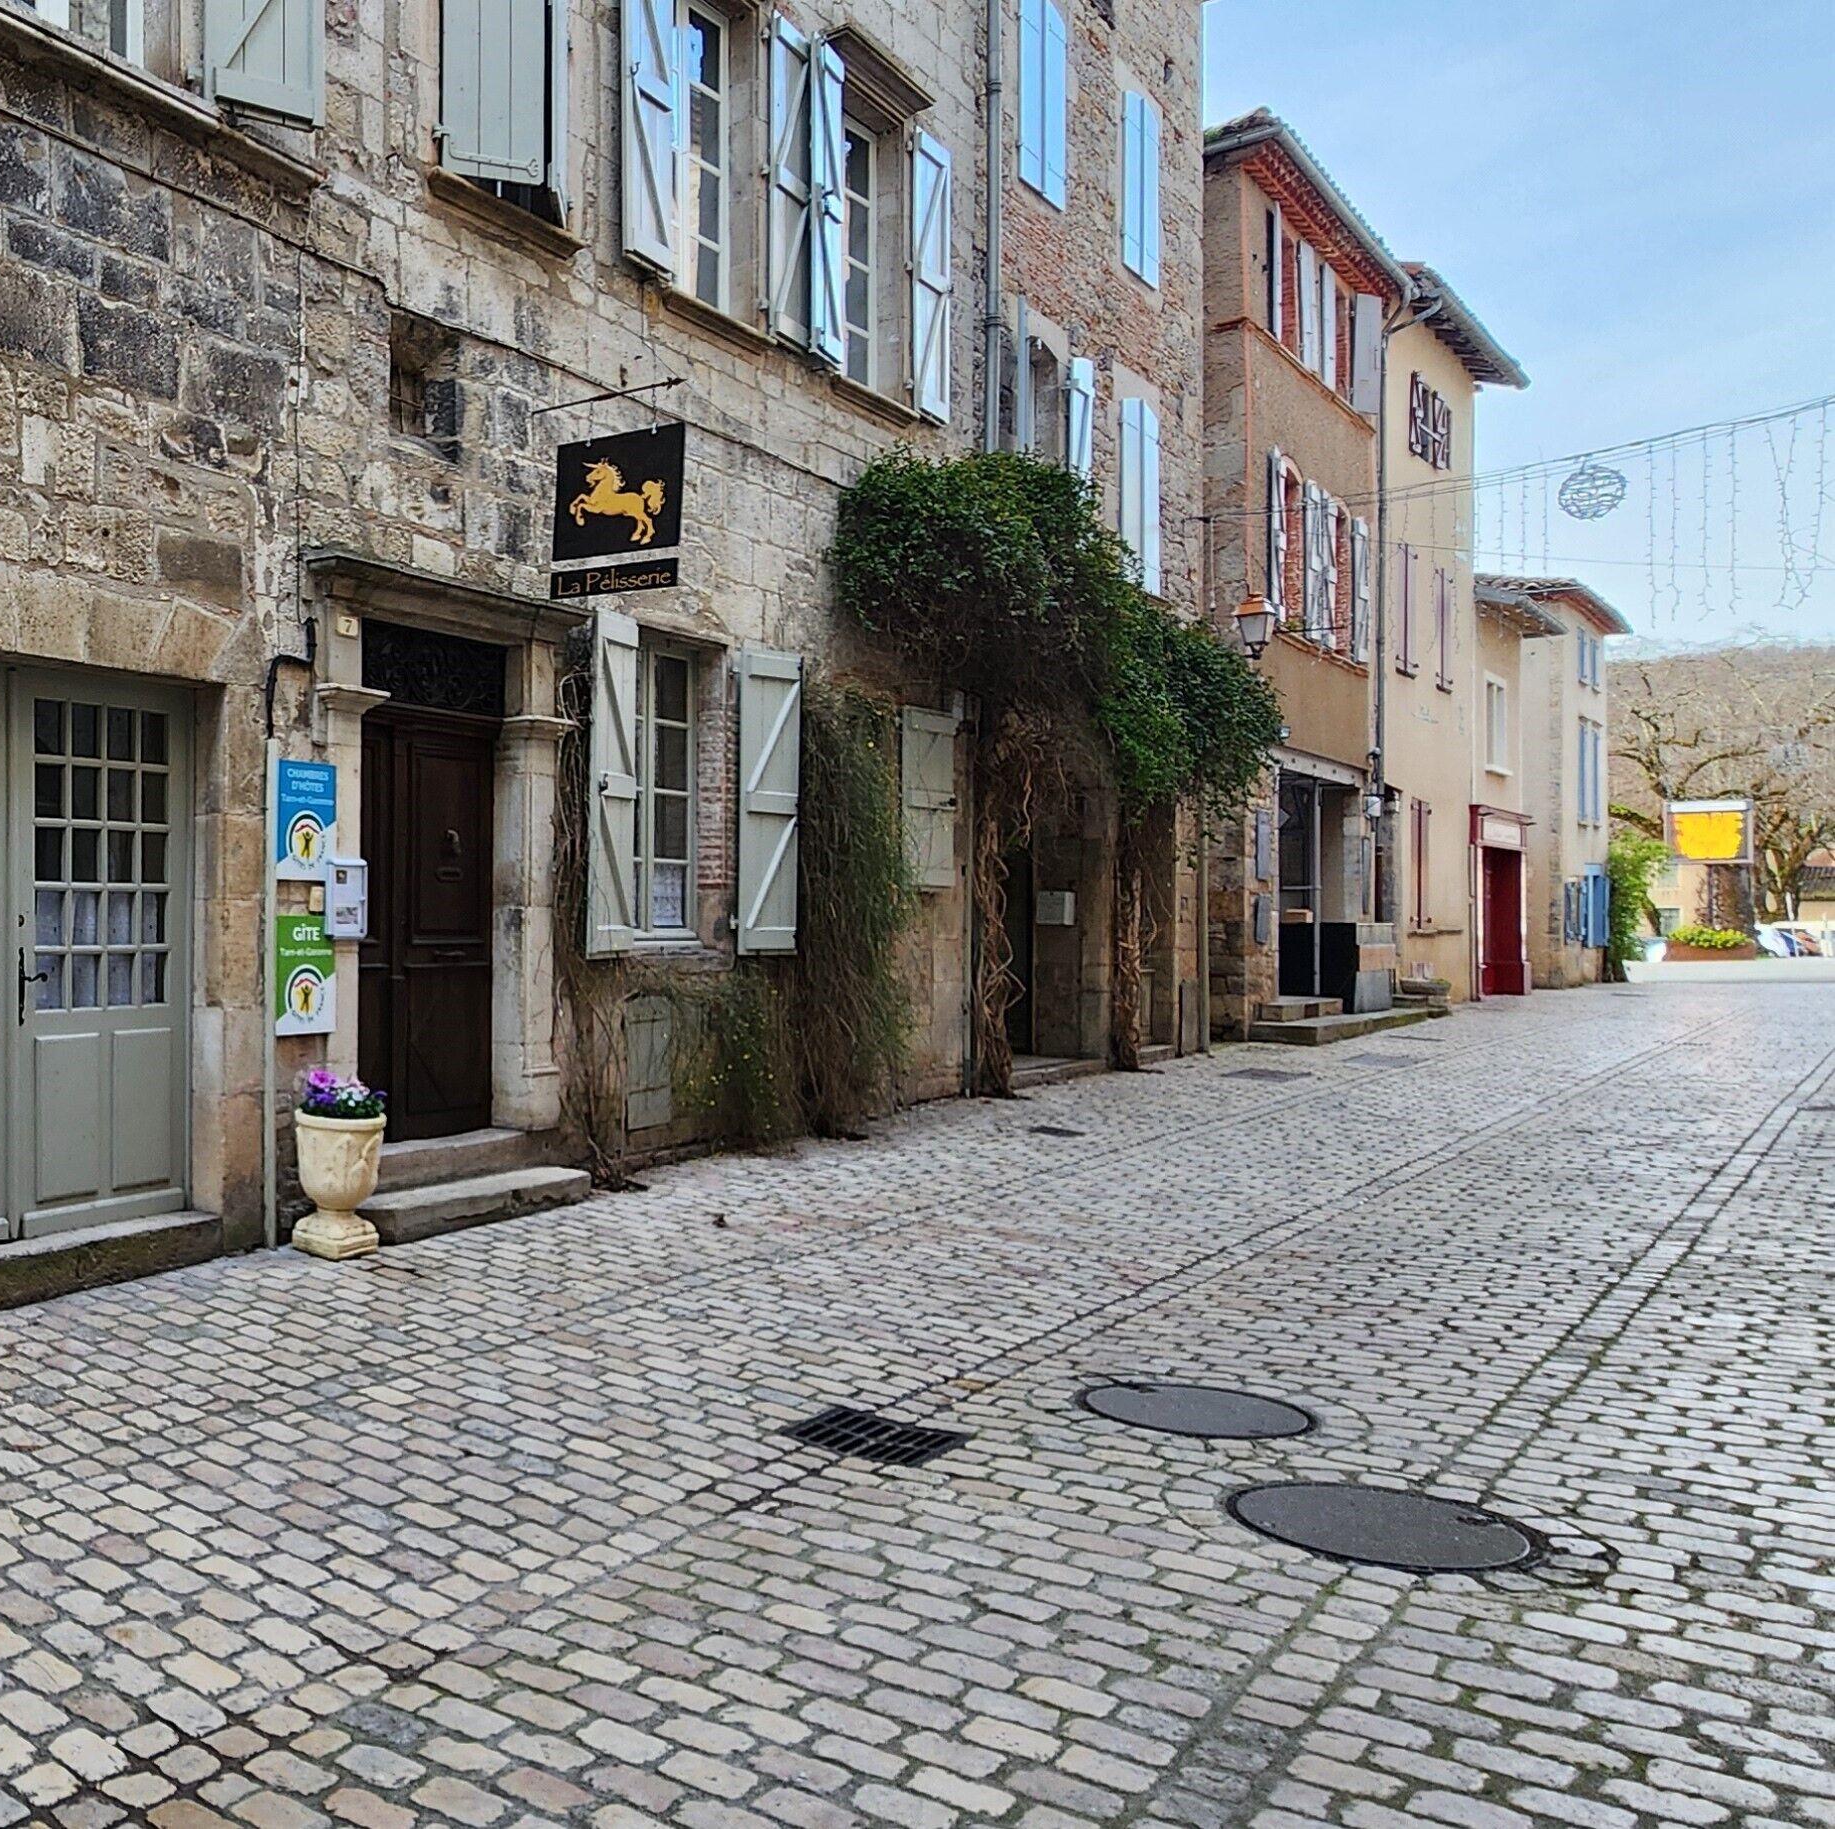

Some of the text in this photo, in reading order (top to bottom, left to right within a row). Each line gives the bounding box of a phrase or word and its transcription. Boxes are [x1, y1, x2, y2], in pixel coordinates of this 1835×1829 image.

[557, 567, 672, 596] La Pélisserie
[344, 619, 352, 633] 7
